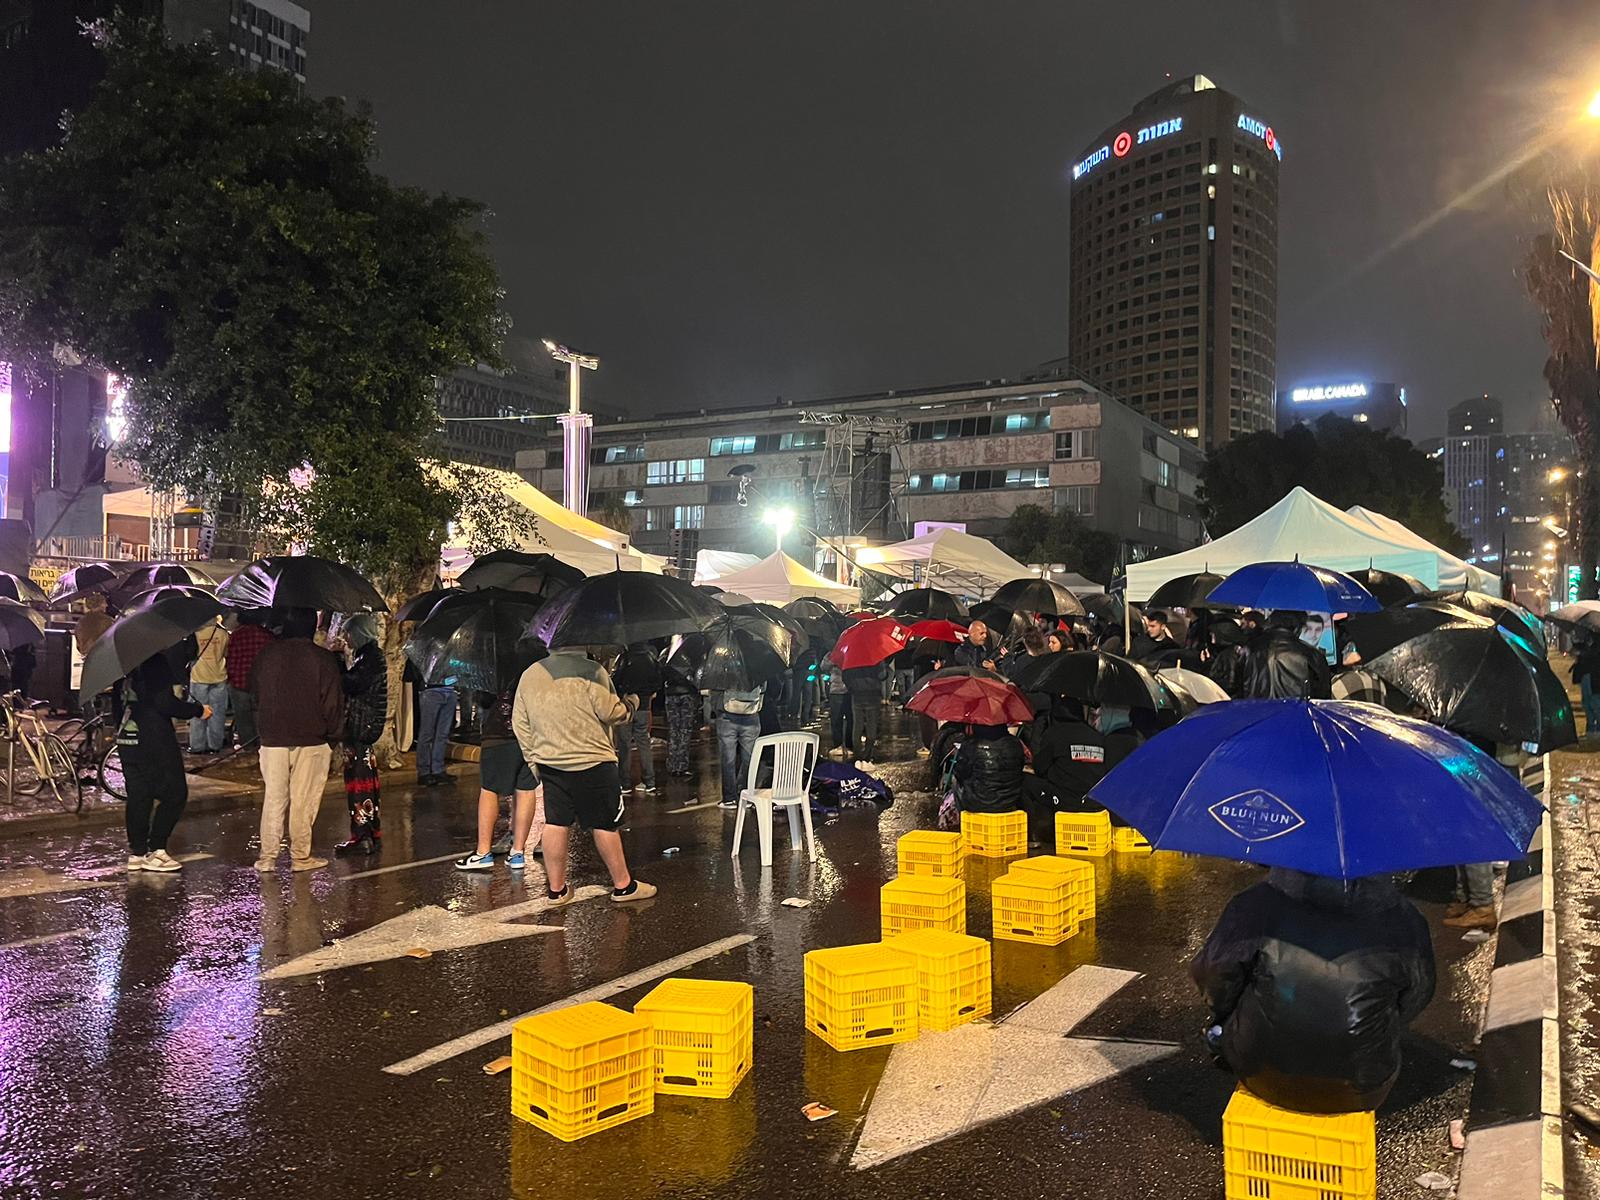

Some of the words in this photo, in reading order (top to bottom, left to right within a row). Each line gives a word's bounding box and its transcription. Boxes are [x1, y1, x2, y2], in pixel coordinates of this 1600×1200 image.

[1137, 116, 1182, 144] אמות
[1237, 113, 1266, 140] AMOT
[1259, 811, 1290, 825] NUN
